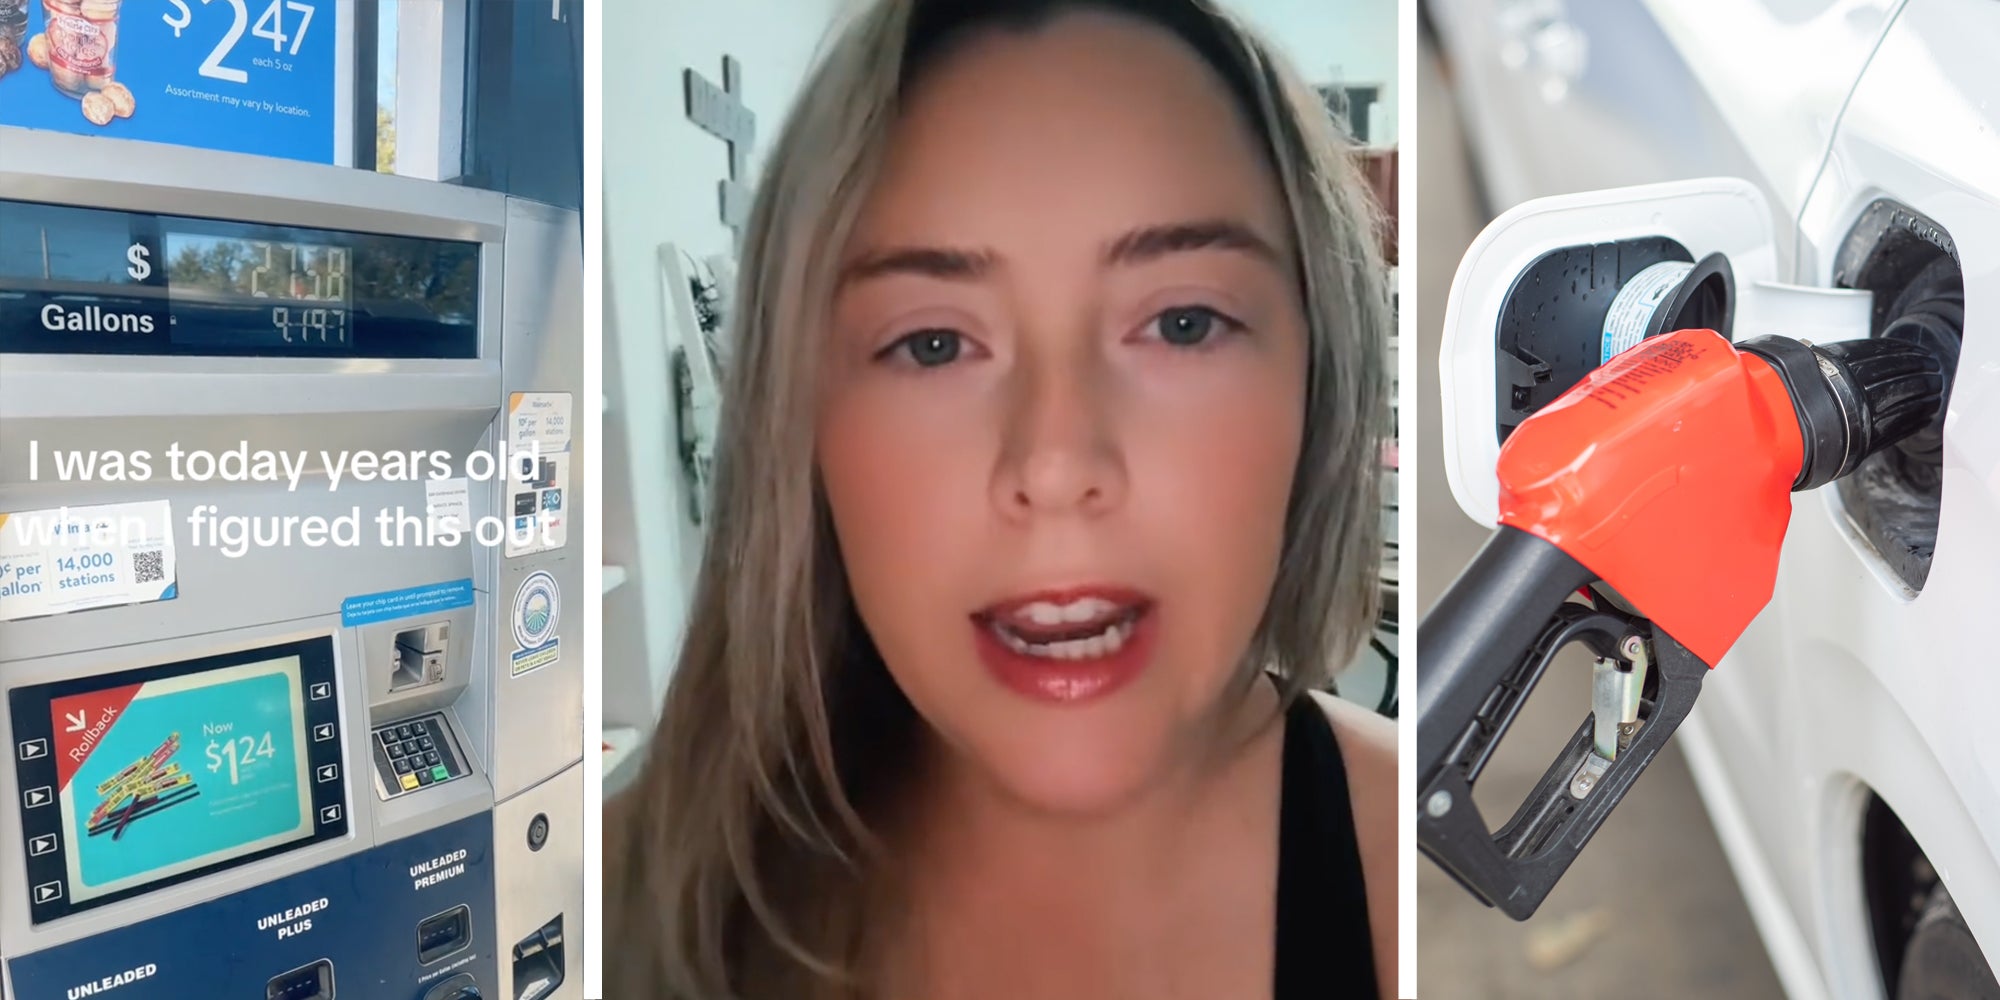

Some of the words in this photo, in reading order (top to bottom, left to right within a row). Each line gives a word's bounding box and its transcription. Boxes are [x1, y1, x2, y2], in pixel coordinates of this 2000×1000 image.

[252, 57, 273, 68] each
[274, 58, 281, 70] 5
[282, 63, 293, 72] oz
[165, 84, 220, 102] Assortment
[222, 95, 240, 108] may
[242, 99, 262, 112] vary
[263, 101, 274, 114] by
[275, 102, 311, 118] location.
[127, 242, 151, 281] $
[41, 304, 154, 333] Gallons
[16, 564, 42, 581] per
[56, 552, 114, 573] 14,000
[0, 581, 42, 598] allon
[59, 572, 116, 589] stations
[69, 706, 118, 762] Rollback
[203, 722, 233, 736] Now
[205, 731, 276, 785] $124
[410, 848, 467, 877] UNLEADED
[414, 864, 465, 890] PREMIUM
[257, 897, 329, 930] UNLEADED
[278, 919, 312, 940] PLUS
[67, 963, 157, 1000] UNLEADED
